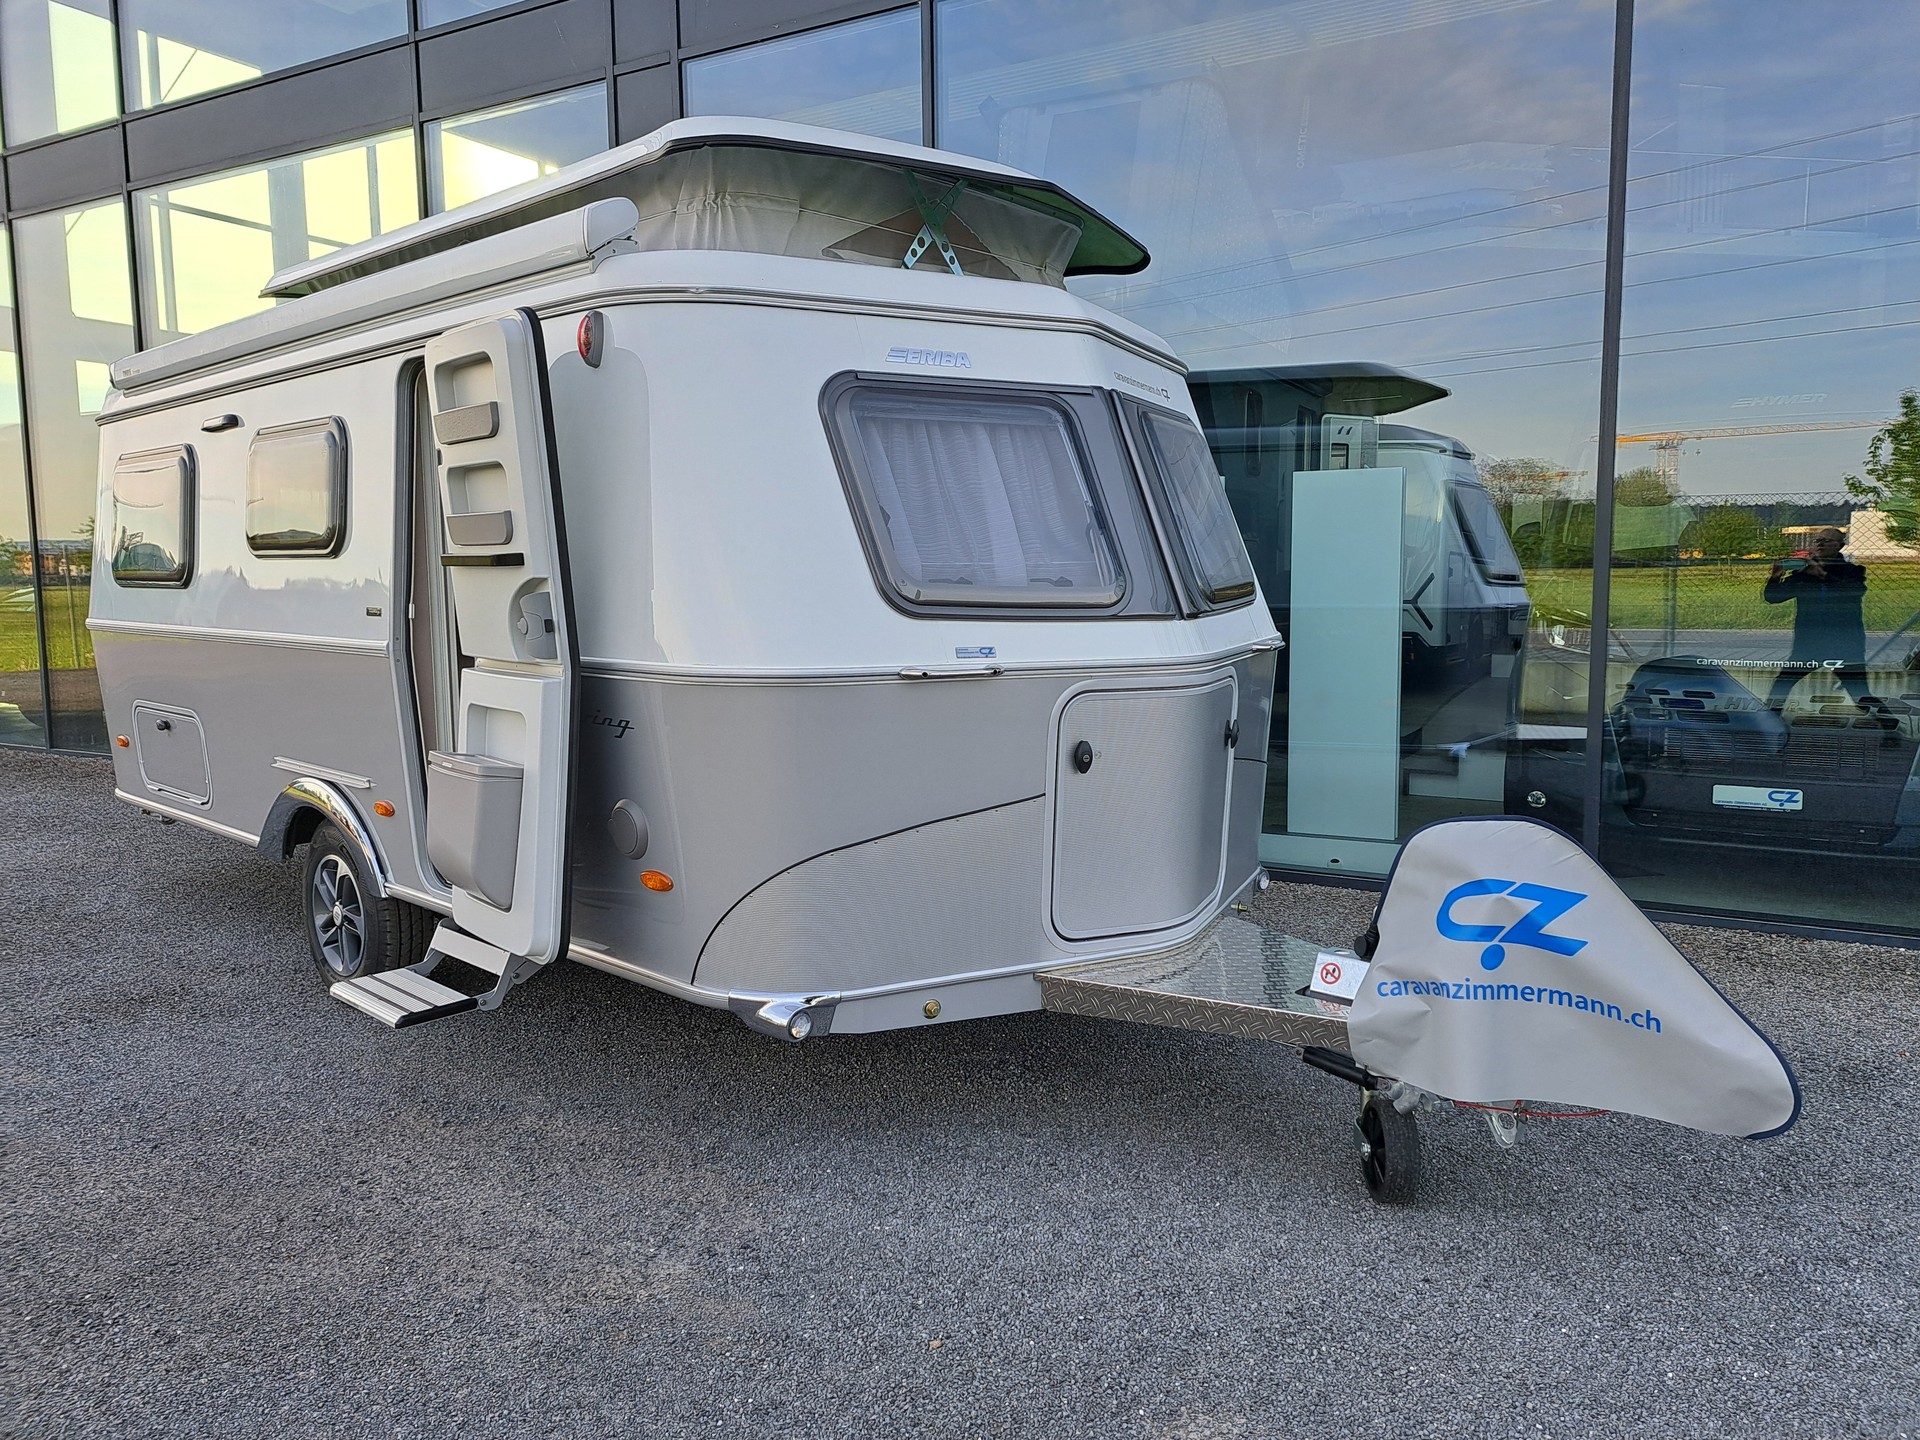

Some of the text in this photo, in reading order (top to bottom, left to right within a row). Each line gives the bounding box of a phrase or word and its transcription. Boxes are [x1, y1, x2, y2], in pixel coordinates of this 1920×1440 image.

[905, 347, 972, 368] ERIBA
[1696, 658, 1845, 671] caravanzimmermann.ch CZ
[589, 709, 635, 739] ing
[1767, 790, 1801, 808] CZ
[1436, 878, 1588, 971] CZ
[1377, 976, 1662, 1034] caravanzimmermann.ch
